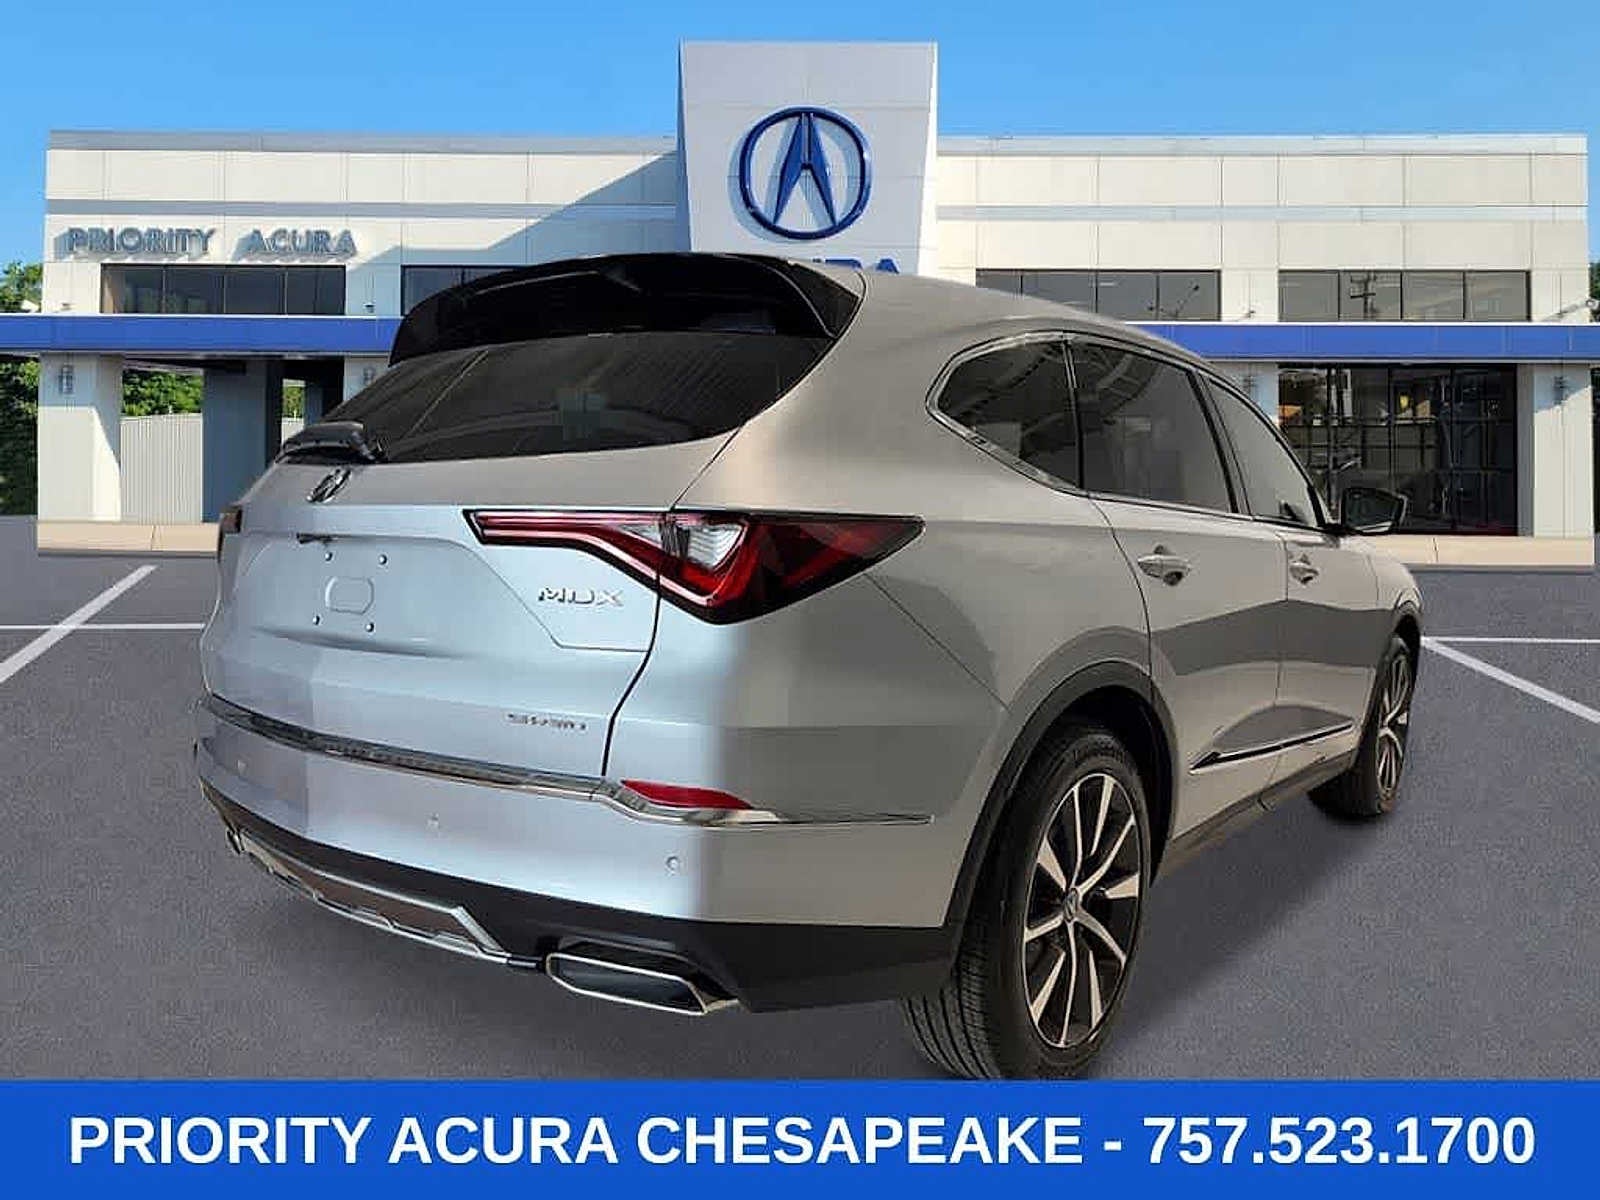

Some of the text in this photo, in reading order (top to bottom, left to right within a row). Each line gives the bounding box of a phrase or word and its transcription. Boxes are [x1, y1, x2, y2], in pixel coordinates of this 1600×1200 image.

[67, 227, 357, 255] PRIORITY ACURA
[537, 585, 624, 607] MDX
